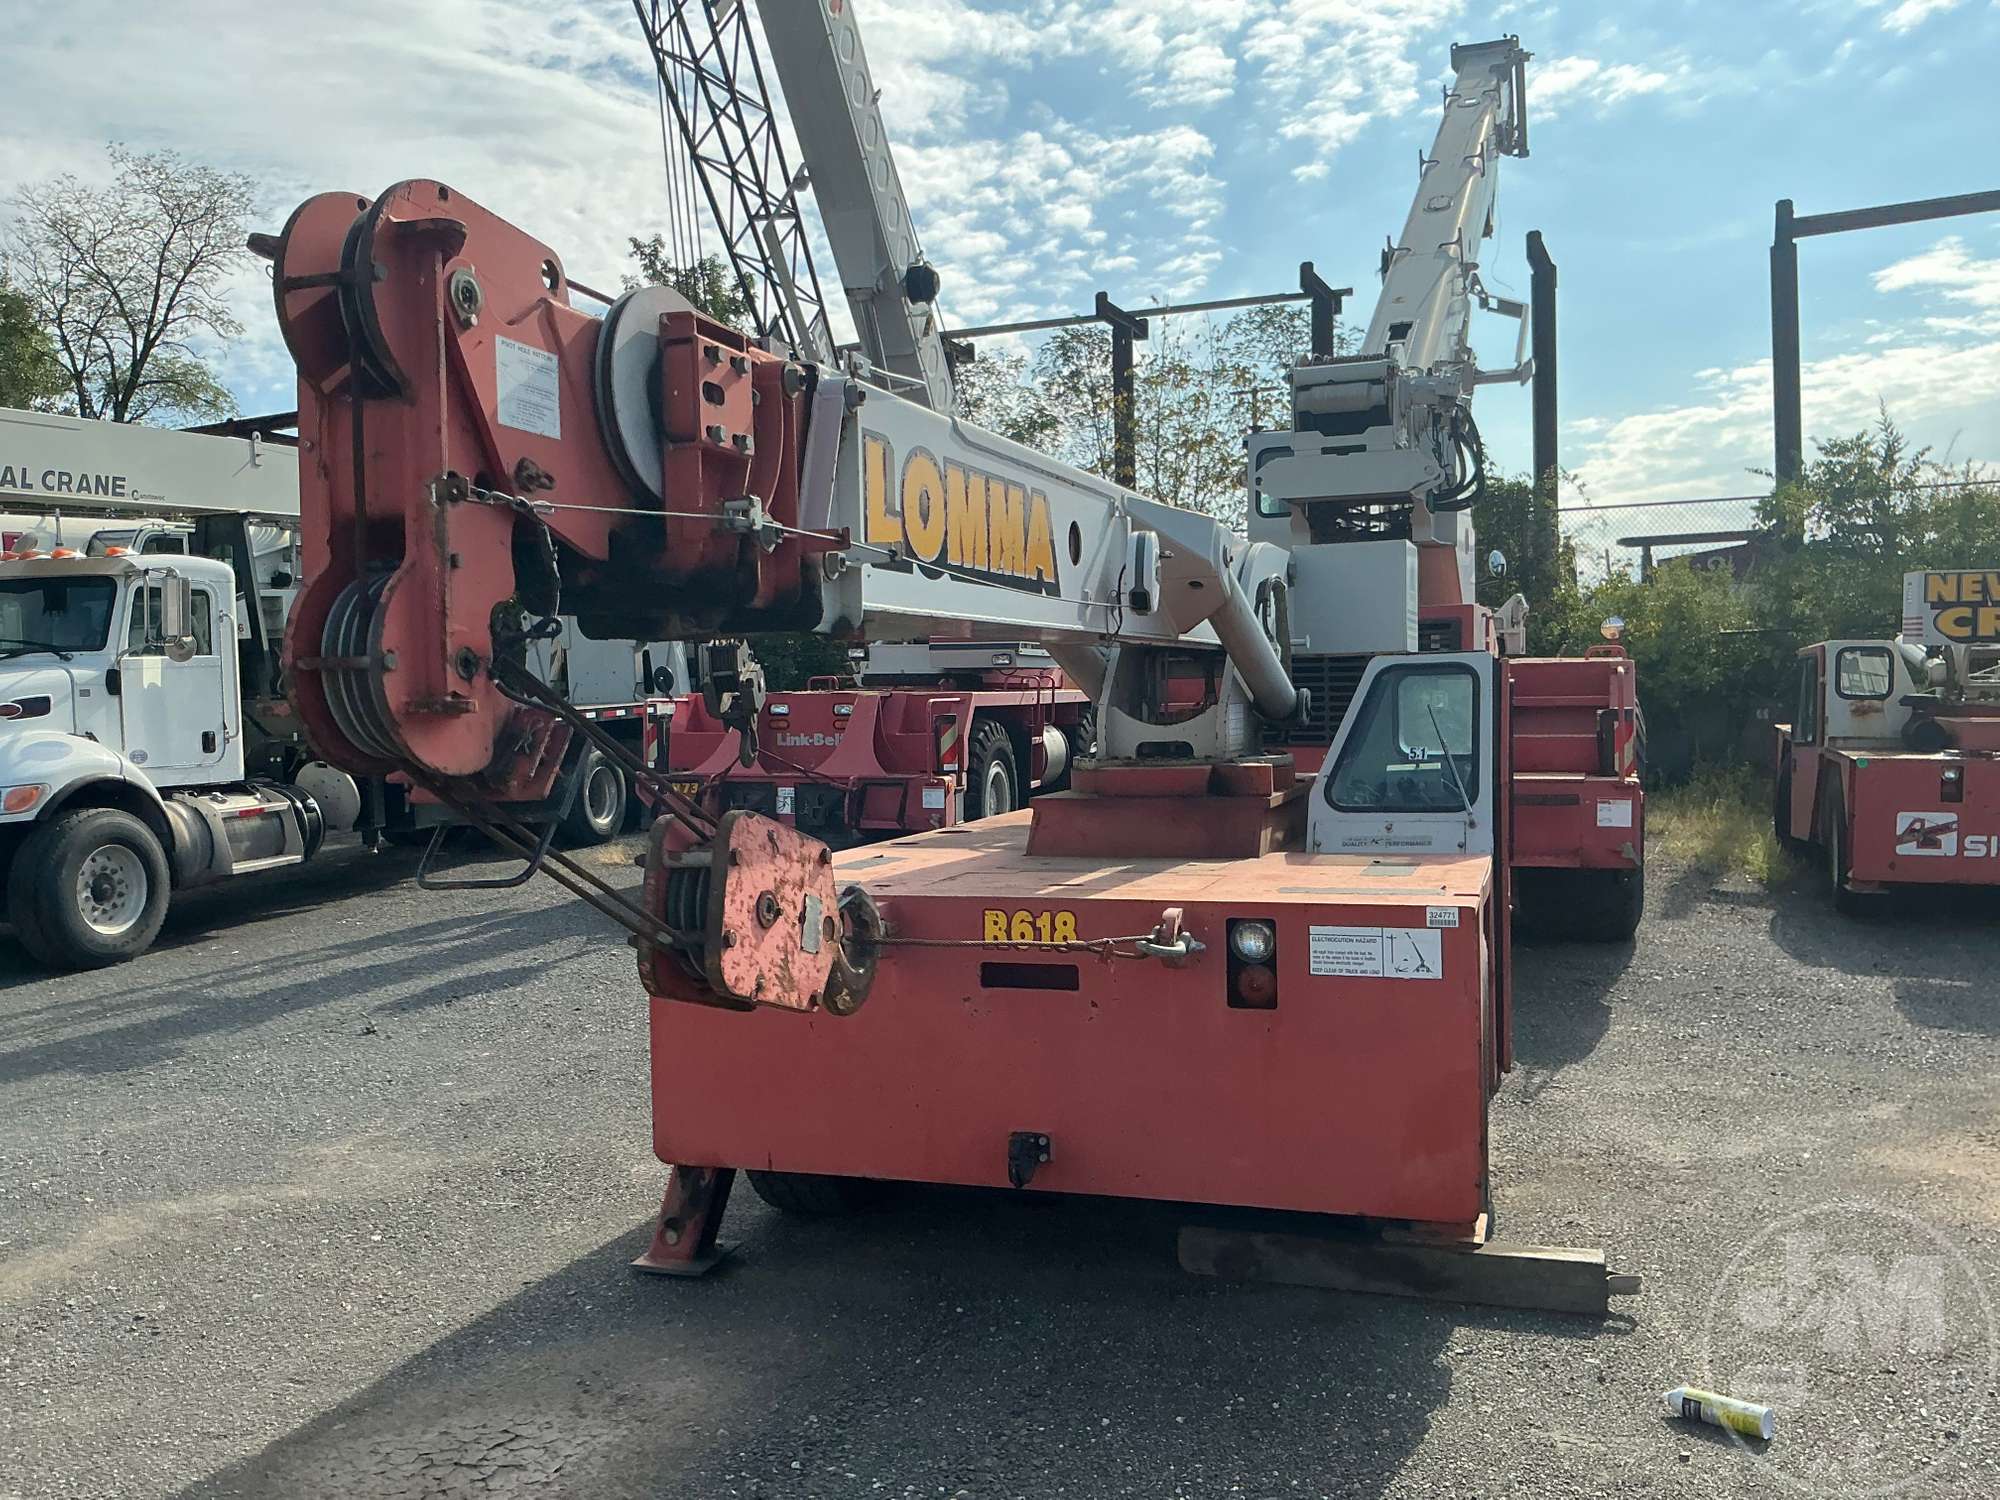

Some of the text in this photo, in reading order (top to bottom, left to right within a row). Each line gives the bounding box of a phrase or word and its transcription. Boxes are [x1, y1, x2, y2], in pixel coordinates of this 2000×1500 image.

[0, 465, 126, 498] AL CRANE
[864, 432, 1057, 584] LOMMA
[982, 908, 1077, 953] R618
[1428, 911, 1456, 920] 324771
